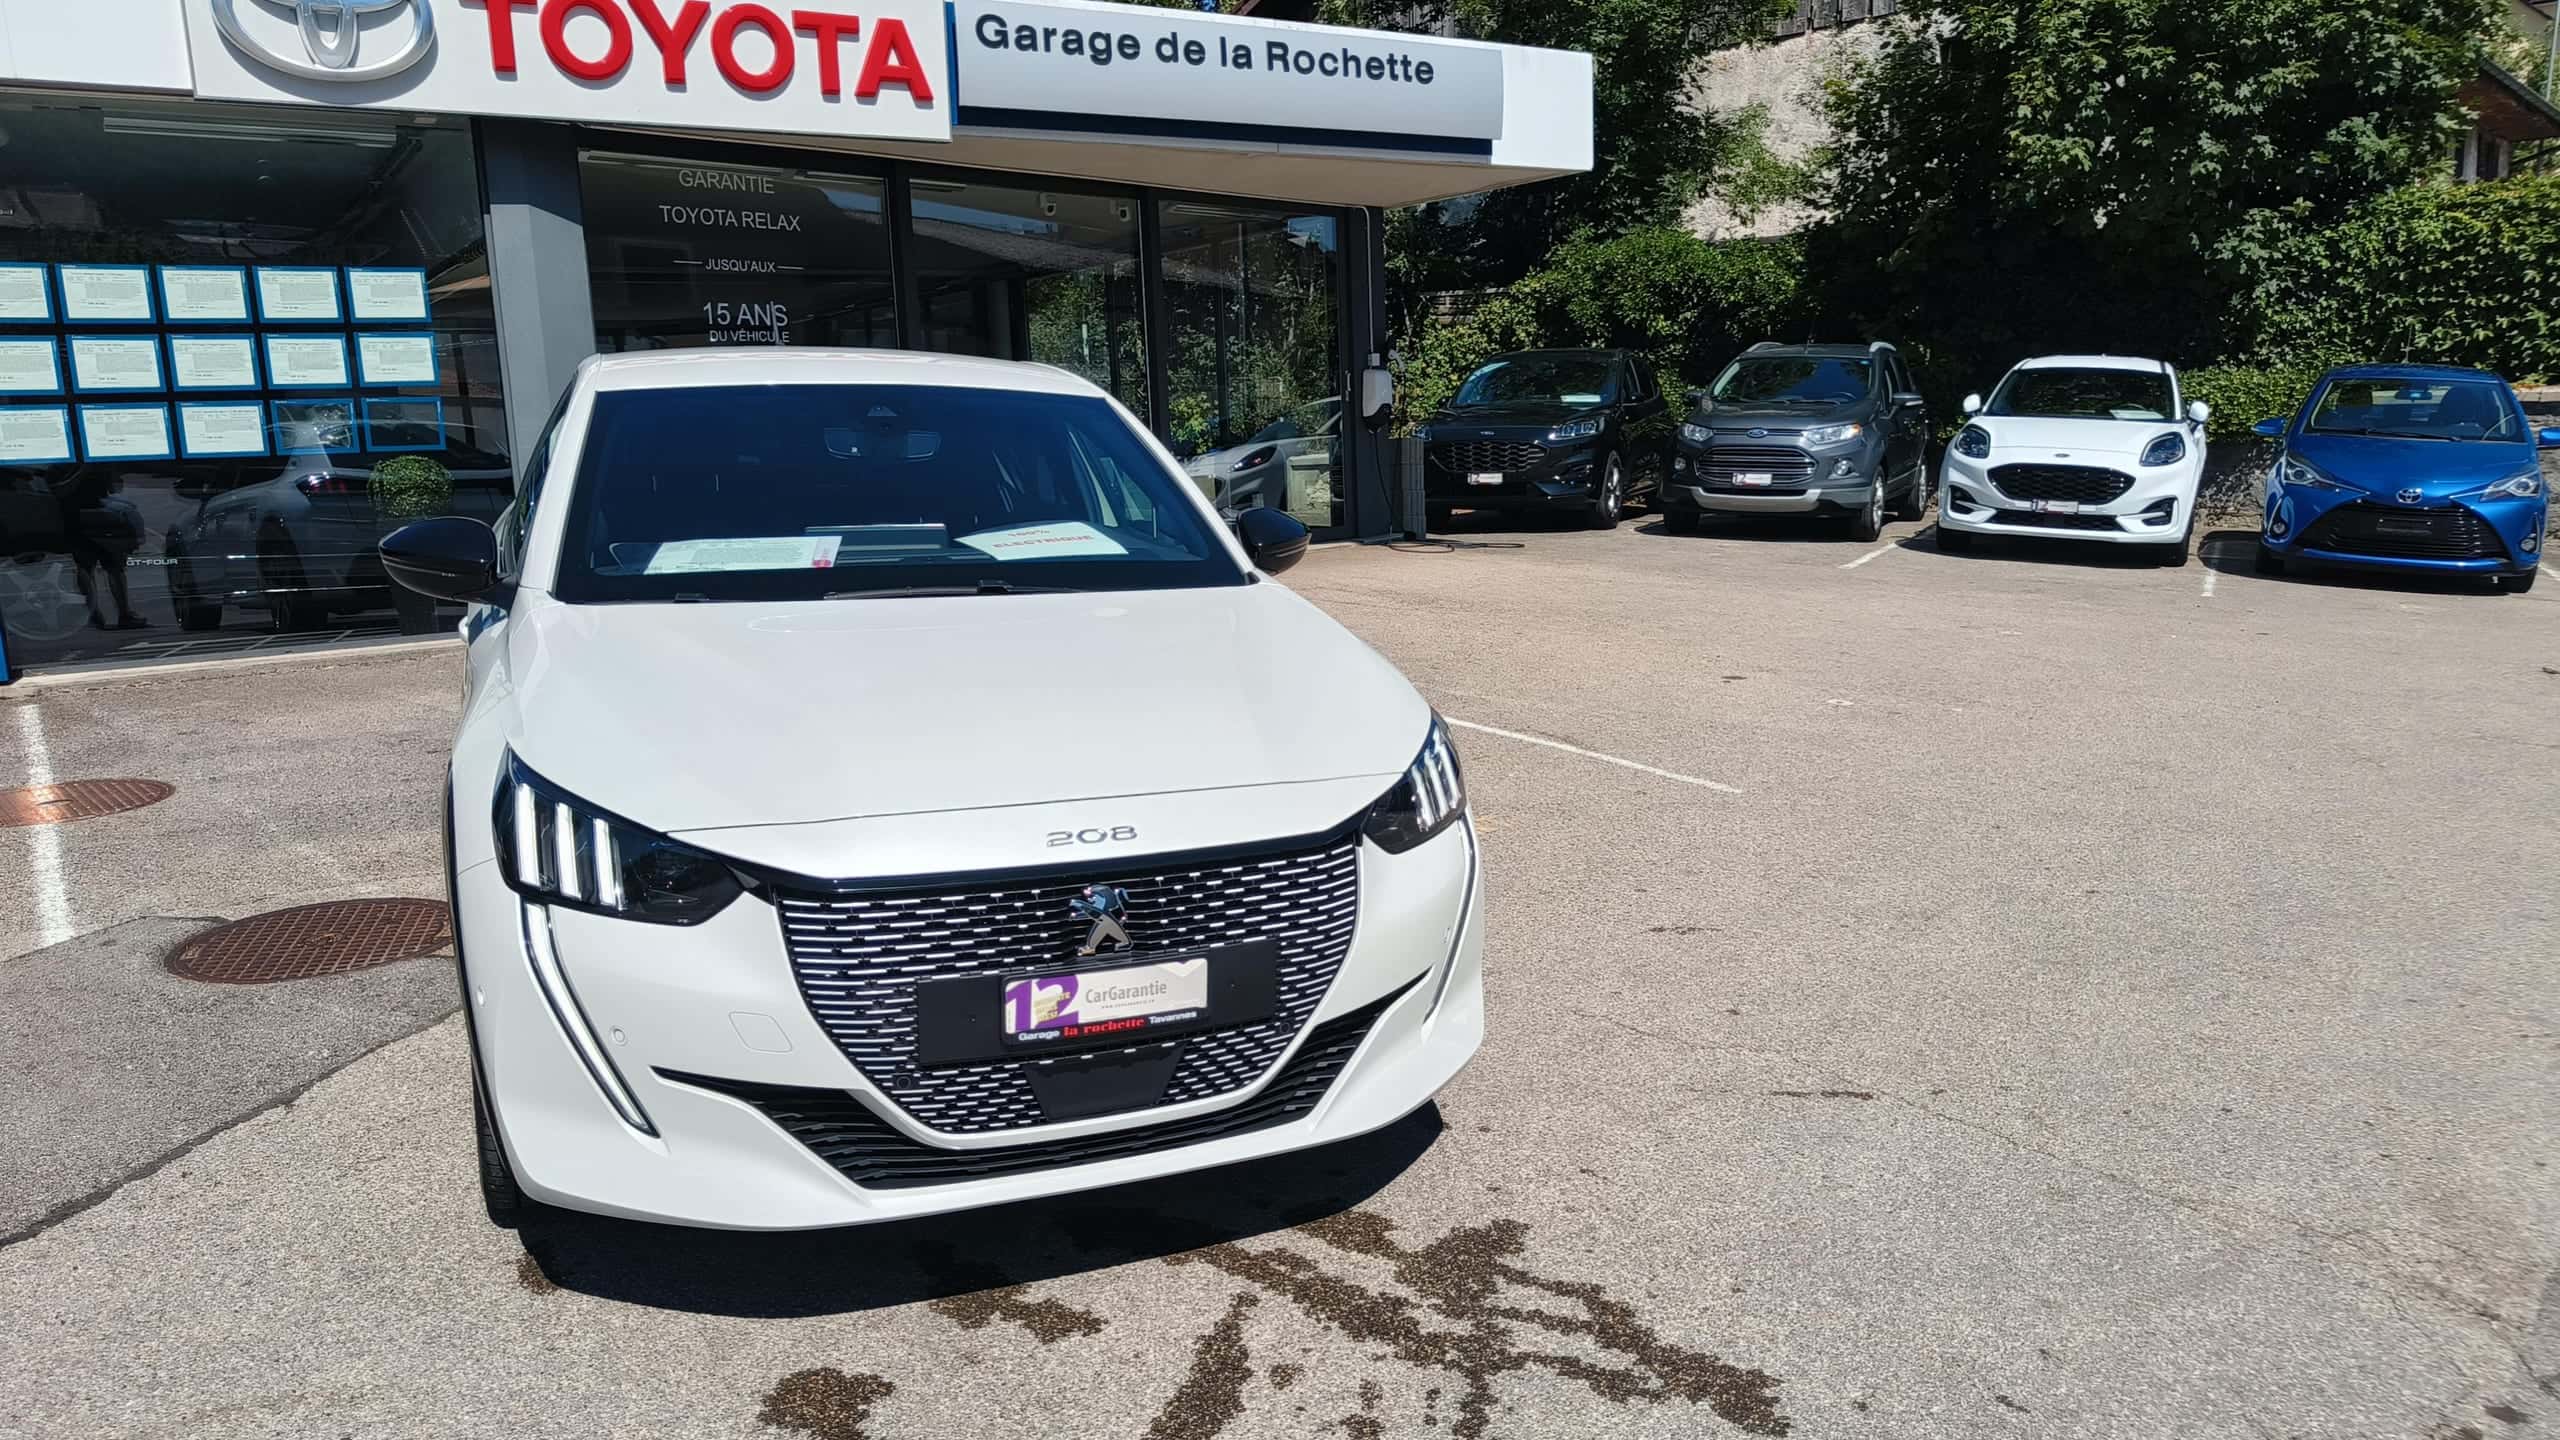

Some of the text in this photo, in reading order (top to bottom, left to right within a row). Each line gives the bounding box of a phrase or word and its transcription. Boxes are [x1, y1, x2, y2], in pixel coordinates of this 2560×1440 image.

[460, 0, 934, 102] TOYOTA
[975, 14, 1435, 85] Garage de la Rochette
[678, 169, 776, 194] GARANTIE
[658, 205, 801, 232] TOYOTA RELAX
[705, 258, 776, 272] JUSQU'AUX
[703, 302, 789, 327] 15 ANS
[709, 330, 728, 342] DU
[1046, 825, 1138, 847] 208
[1006, 974, 1080, 1033] 12
[1085, 980, 1167, 1004] CarGarantie
[1018, 1029, 1061, 1041] Garage
[1063, 1025, 1078, 1037] la
